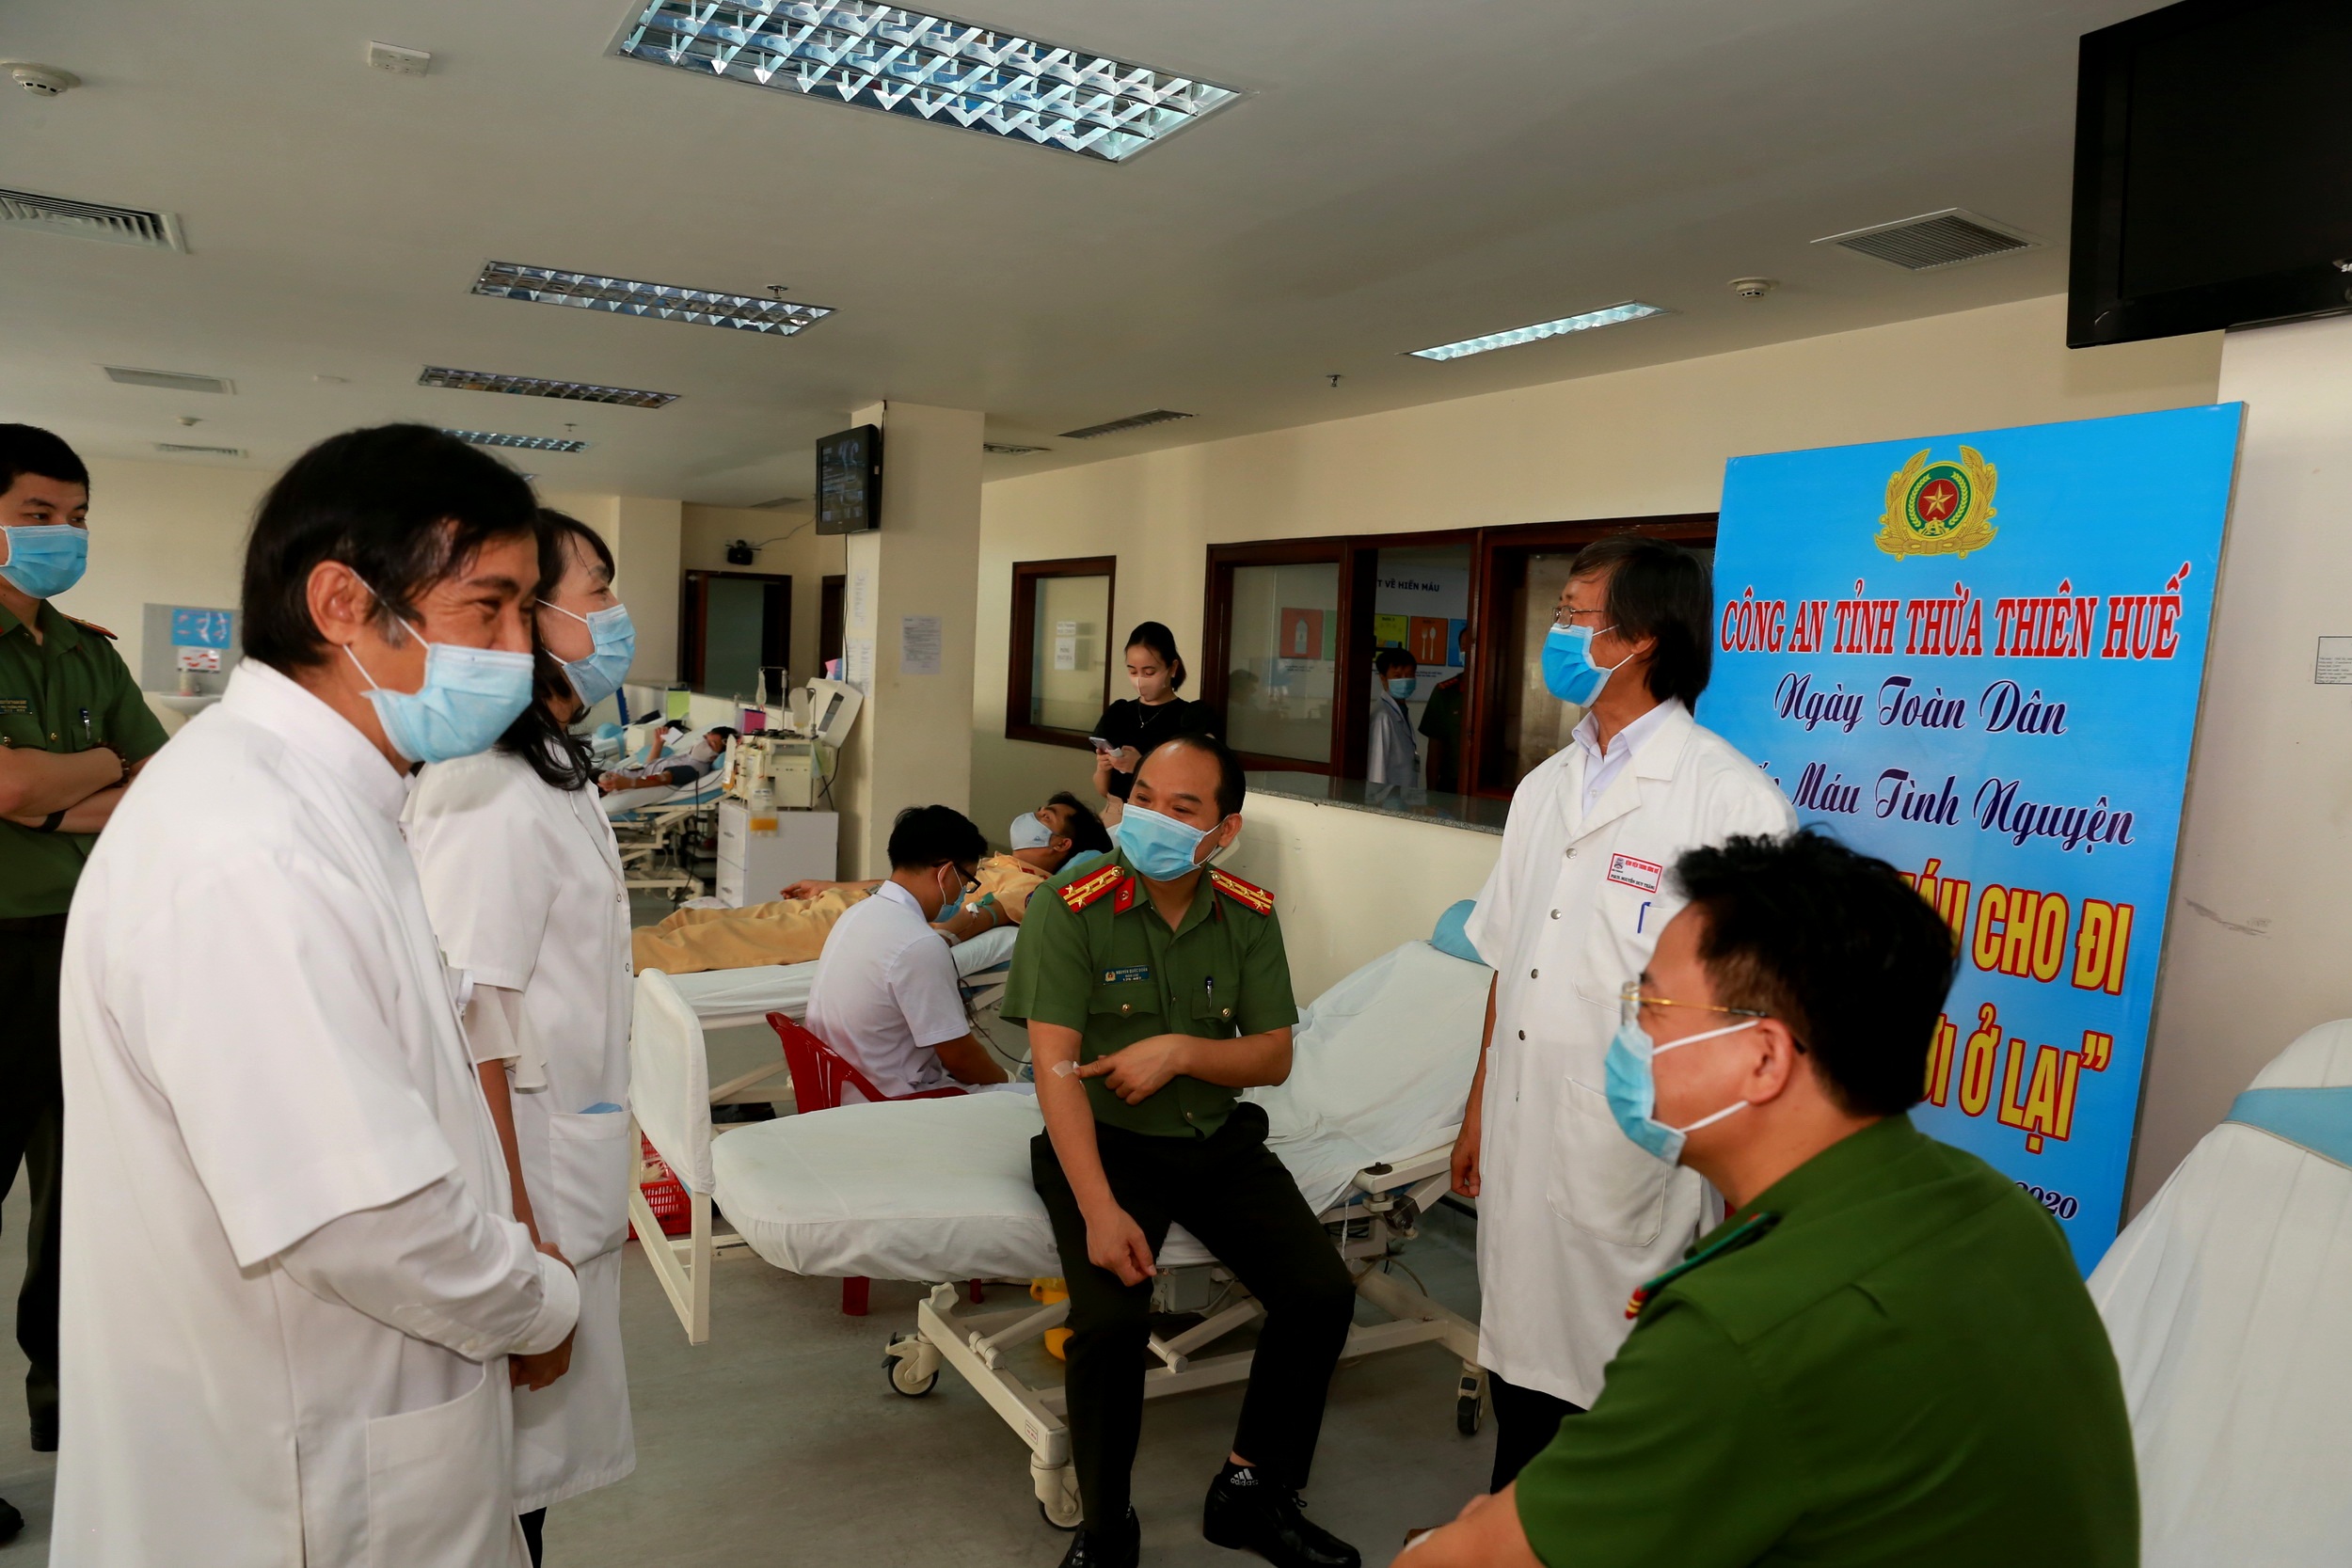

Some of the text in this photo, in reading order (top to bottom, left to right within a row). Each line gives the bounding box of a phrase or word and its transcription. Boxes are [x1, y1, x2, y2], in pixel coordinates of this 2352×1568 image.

[1720, 562, 2191, 660] CÔNG AN TỈNH THỪA THIÊN HUẾ
[1773, 672, 2067, 736] Ngày Toàn Dân
[1787, 761, 1861, 816] Máu
[1874, 768, 1960, 826] Tình
[1973, 777, 2135, 853] Nguyện
[1972, 884, 2069, 983] CHO
[2072, 898, 2134, 996] ĐI
[1958, 1002, 2002, 1117] Ở
[1231, 1478, 1259, 1486] adidas
